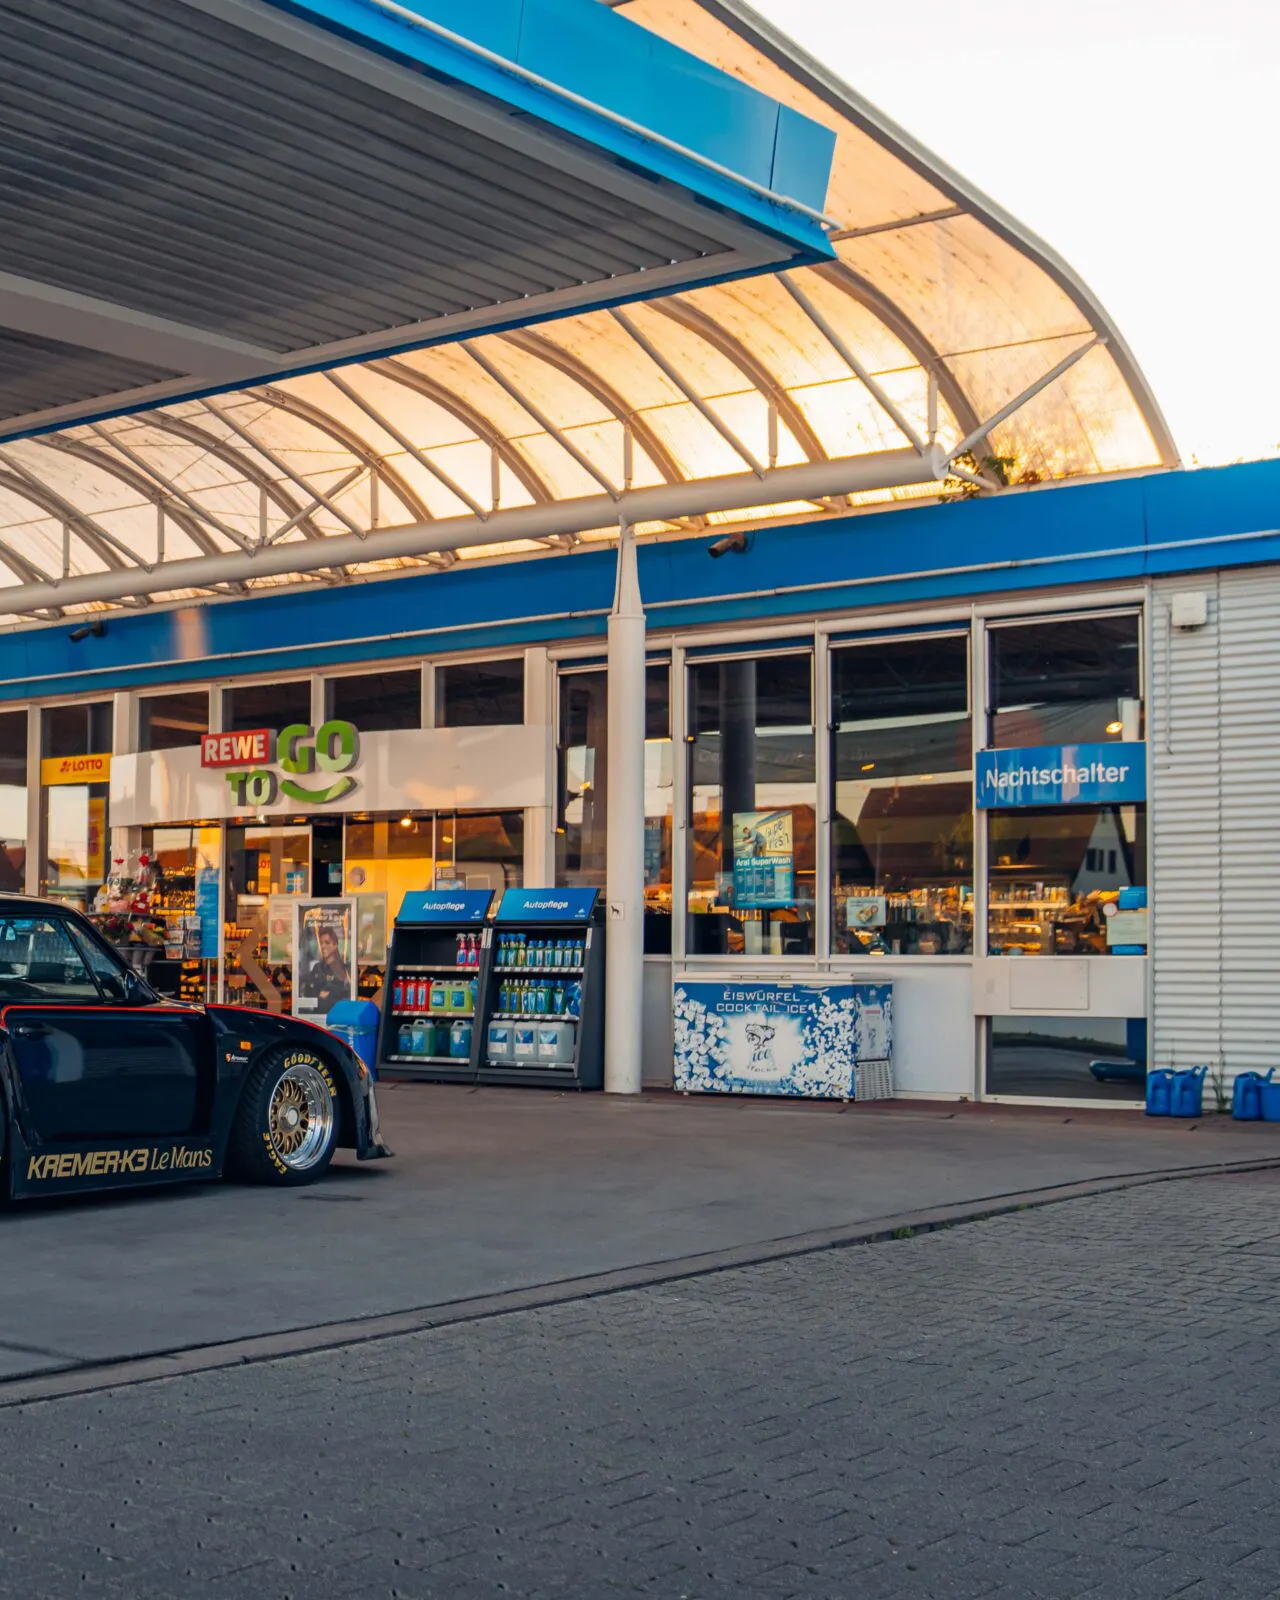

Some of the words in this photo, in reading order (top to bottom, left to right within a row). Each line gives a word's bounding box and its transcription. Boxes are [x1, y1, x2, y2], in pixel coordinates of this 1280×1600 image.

[205, 734, 265, 762] REWE
[278, 720, 358, 773] GO
[72, 759, 103, 771] LOTTO
[986, 762, 1130, 788] Nachtschalter
[225, 770, 273, 806] TO
[736, 858, 750, 867] Aral
[422, 902, 466, 911] Autopflege
[522, 900, 569, 910] Autopflege
[716, 1003, 780, 1013] COCKTAIL
[786, 1004, 808, 1014] ICE
